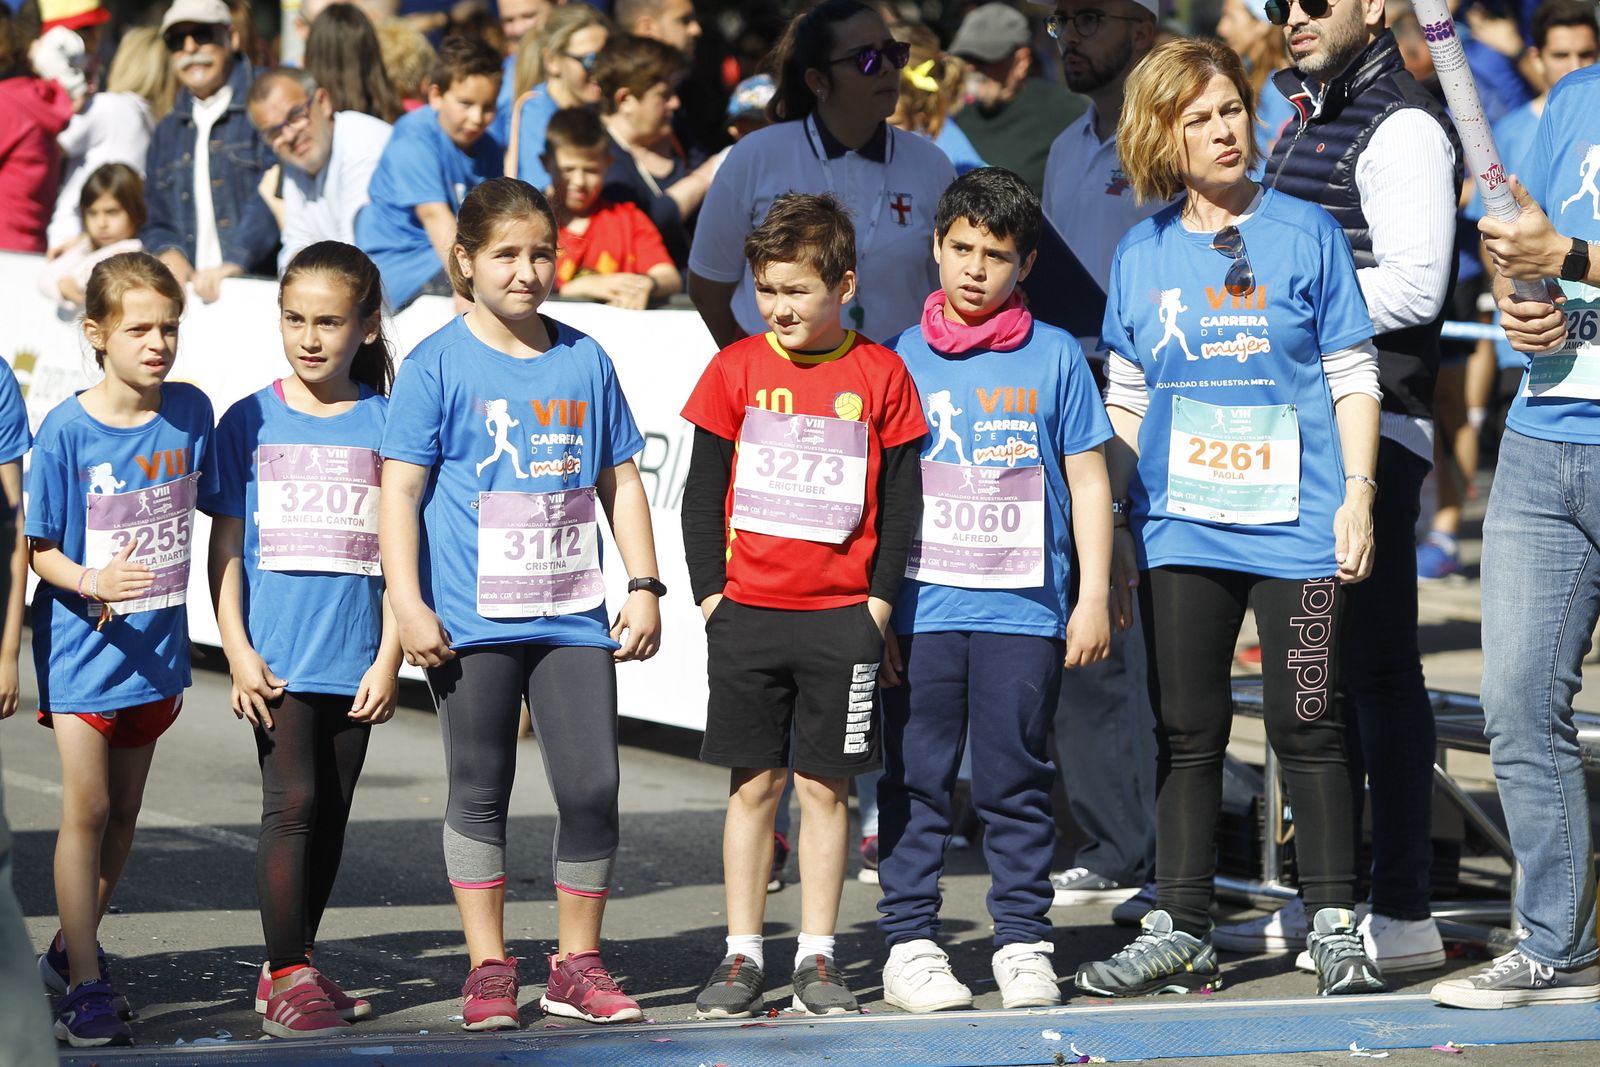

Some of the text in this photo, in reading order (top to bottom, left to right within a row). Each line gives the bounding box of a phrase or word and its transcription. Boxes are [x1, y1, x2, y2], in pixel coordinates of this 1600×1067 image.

[1205, 285, 1266, 310] VIII
[1200, 316, 1268, 327] CARRERA
[1564, 310, 1598, 340] 26
[1210, 379, 1250, 387] NUESTRA
[756, 388, 793, 414] 10
[976, 387, 1037, 414] VIII
[530, 399, 588, 428] VIII
[1230, 409, 1251, 418] VIII
[806, 418, 825, 429] VIII
[974, 420, 1038, 432] CARRERA
[530, 434, 583, 445] CARRERA
[327, 447, 347, 458] VIII
[1188, 437, 1270, 470] 2261
[135, 448, 190, 480] VIII
[756, 447, 844, 486] 3273
[980, 470, 1000, 479] VIII
[1213, 470, 1245, 480] PAOLA
[152, 486, 170, 498] VIII
[768, 480, 826, 495] ERICTUBER
[281, 482, 369, 516] 3207
[548, 494, 565, 504] VIII
[281, 514, 365, 528] DANIELA CANTON
[933, 499, 1020, 532] 3060
[111, 514, 190, 558] 3255
[504, 526, 582, 561] 3112
[952, 533, 998, 543] ALFREDO
[525, 560, 567, 571] CRISTINA
[1287, 578, 1334, 721] adida
[843, 662, 880, 754] PUMA
